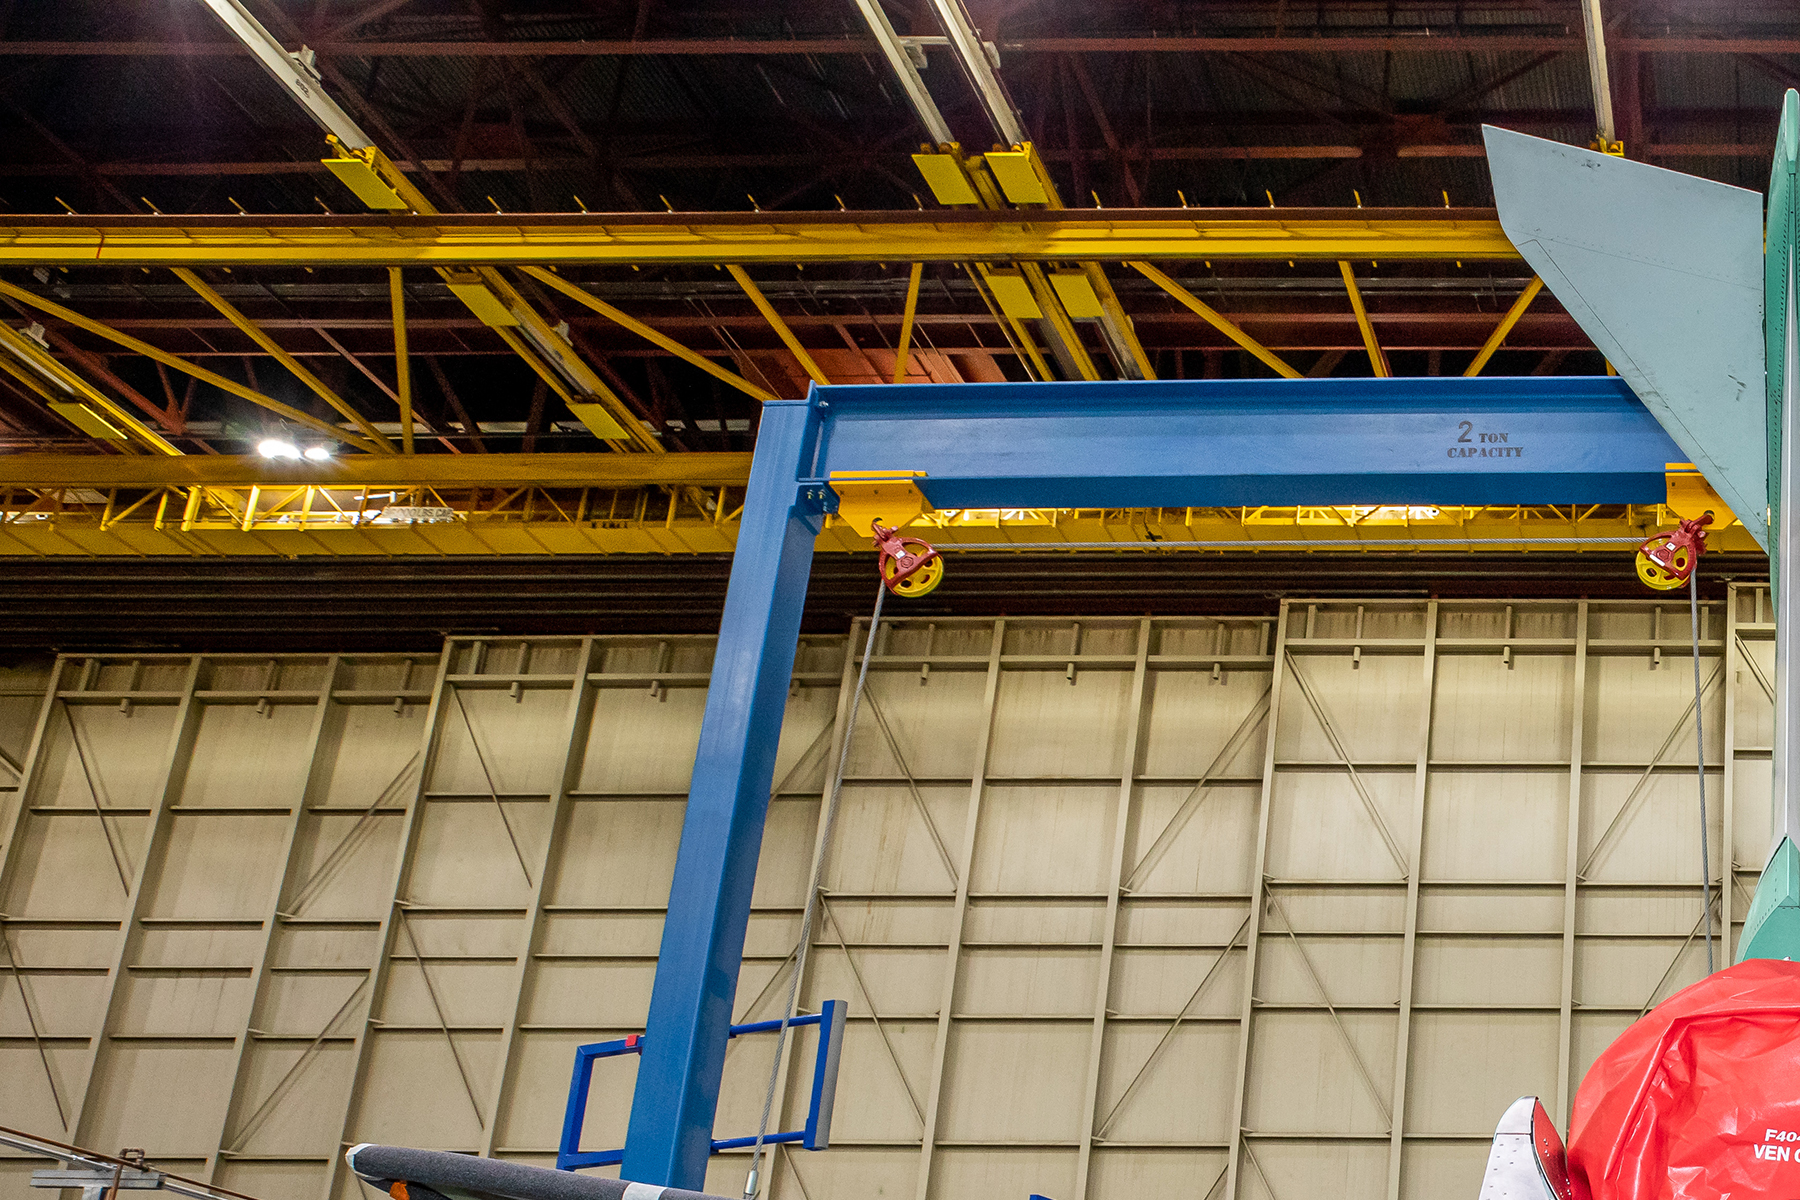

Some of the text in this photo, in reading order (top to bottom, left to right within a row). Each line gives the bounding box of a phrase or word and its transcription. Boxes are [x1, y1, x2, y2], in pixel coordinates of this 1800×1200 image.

[1457, 420, 1509, 443] 2 TON
[1446, 446, 1524, 458] CAPACITY
[1753, 1143, 1791, 1162] VEN
